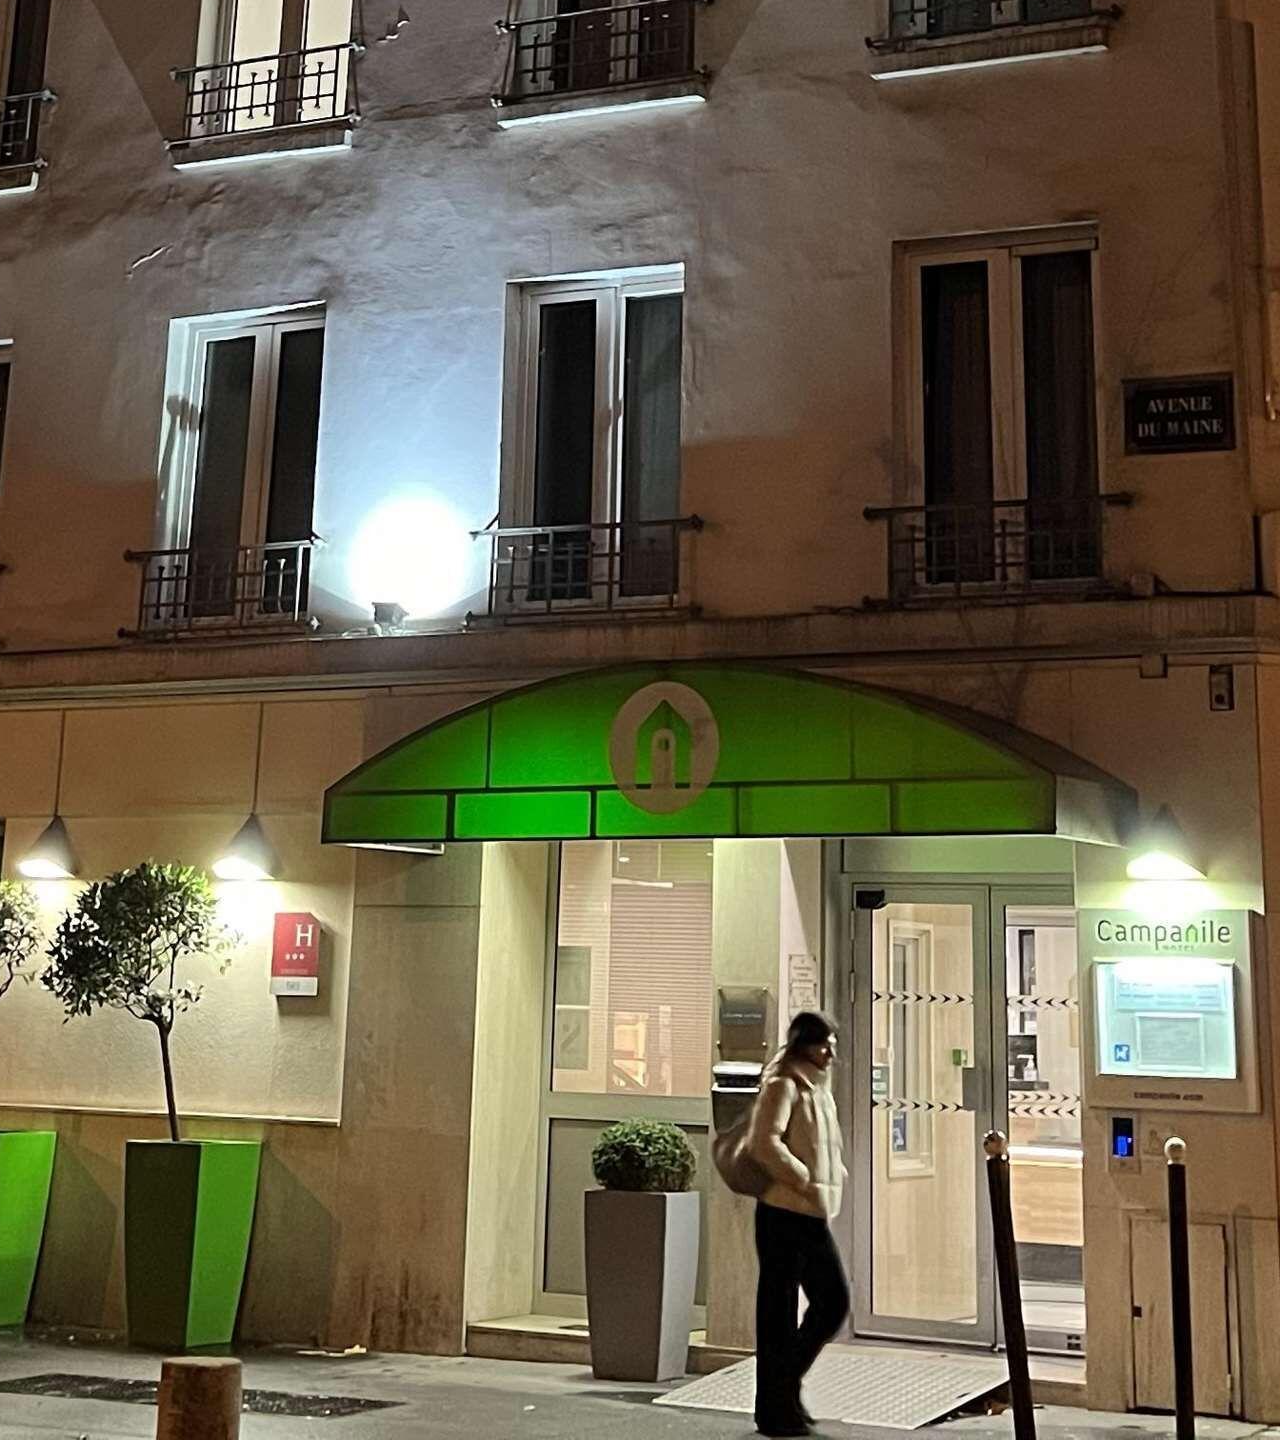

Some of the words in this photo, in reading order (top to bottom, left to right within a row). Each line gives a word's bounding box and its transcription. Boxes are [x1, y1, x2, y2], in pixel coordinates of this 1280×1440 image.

[1147, 395, 1213, 414] AVENUE
[1137, 422, 1162, 438] DU
[1167, 418, 1223, 436] MAINE
[295, 923, 315, 947] H
[1097, 919, 1233, 951] Campanile
